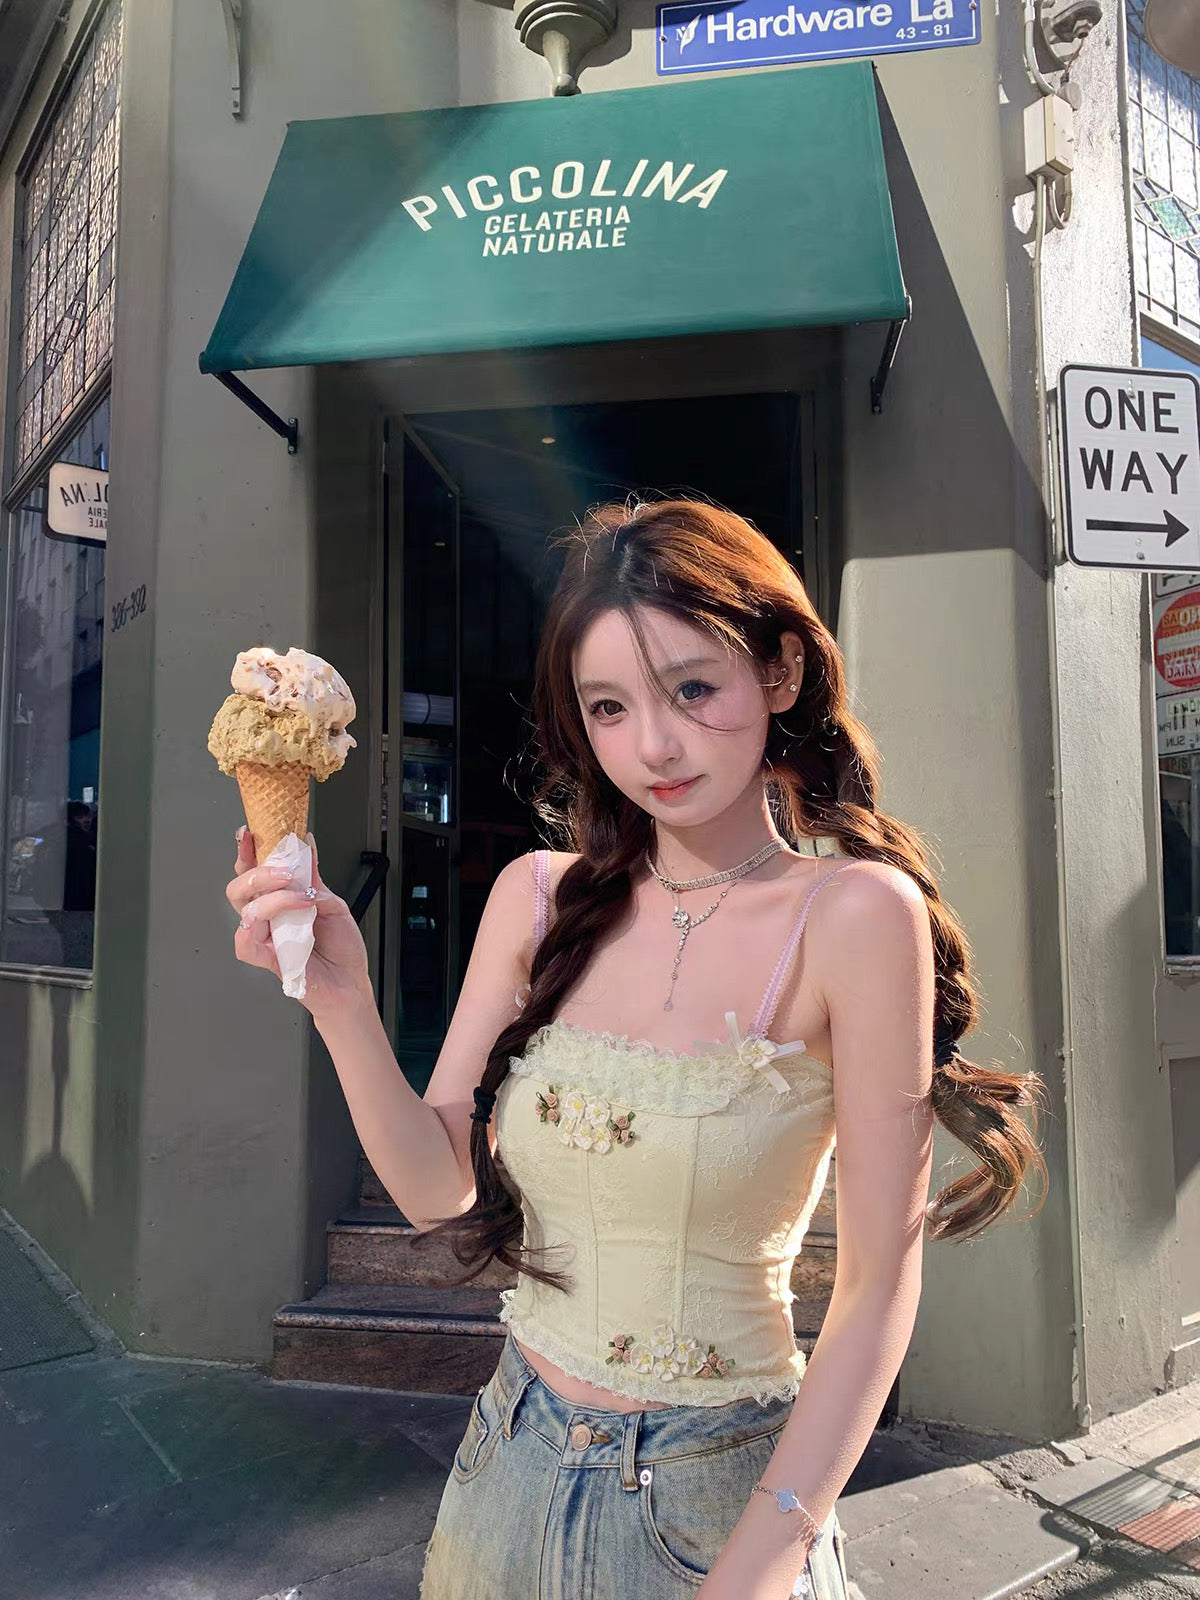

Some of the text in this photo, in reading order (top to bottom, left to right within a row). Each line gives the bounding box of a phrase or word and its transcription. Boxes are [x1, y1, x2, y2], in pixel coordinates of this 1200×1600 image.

[706, 0, 954, 44] Hardware La
[896, 27, 916, 39] 43
[933, 24, 951, 36] 81
[401, 159, 728, 232] PICCOLINA
[482, 227, 628, 257] NATURALE
[484, 205, 631, 235] GELATERIA
[1084, 385, 1179, 434] ONE
[1079, 447, 1188, 495] WAY
